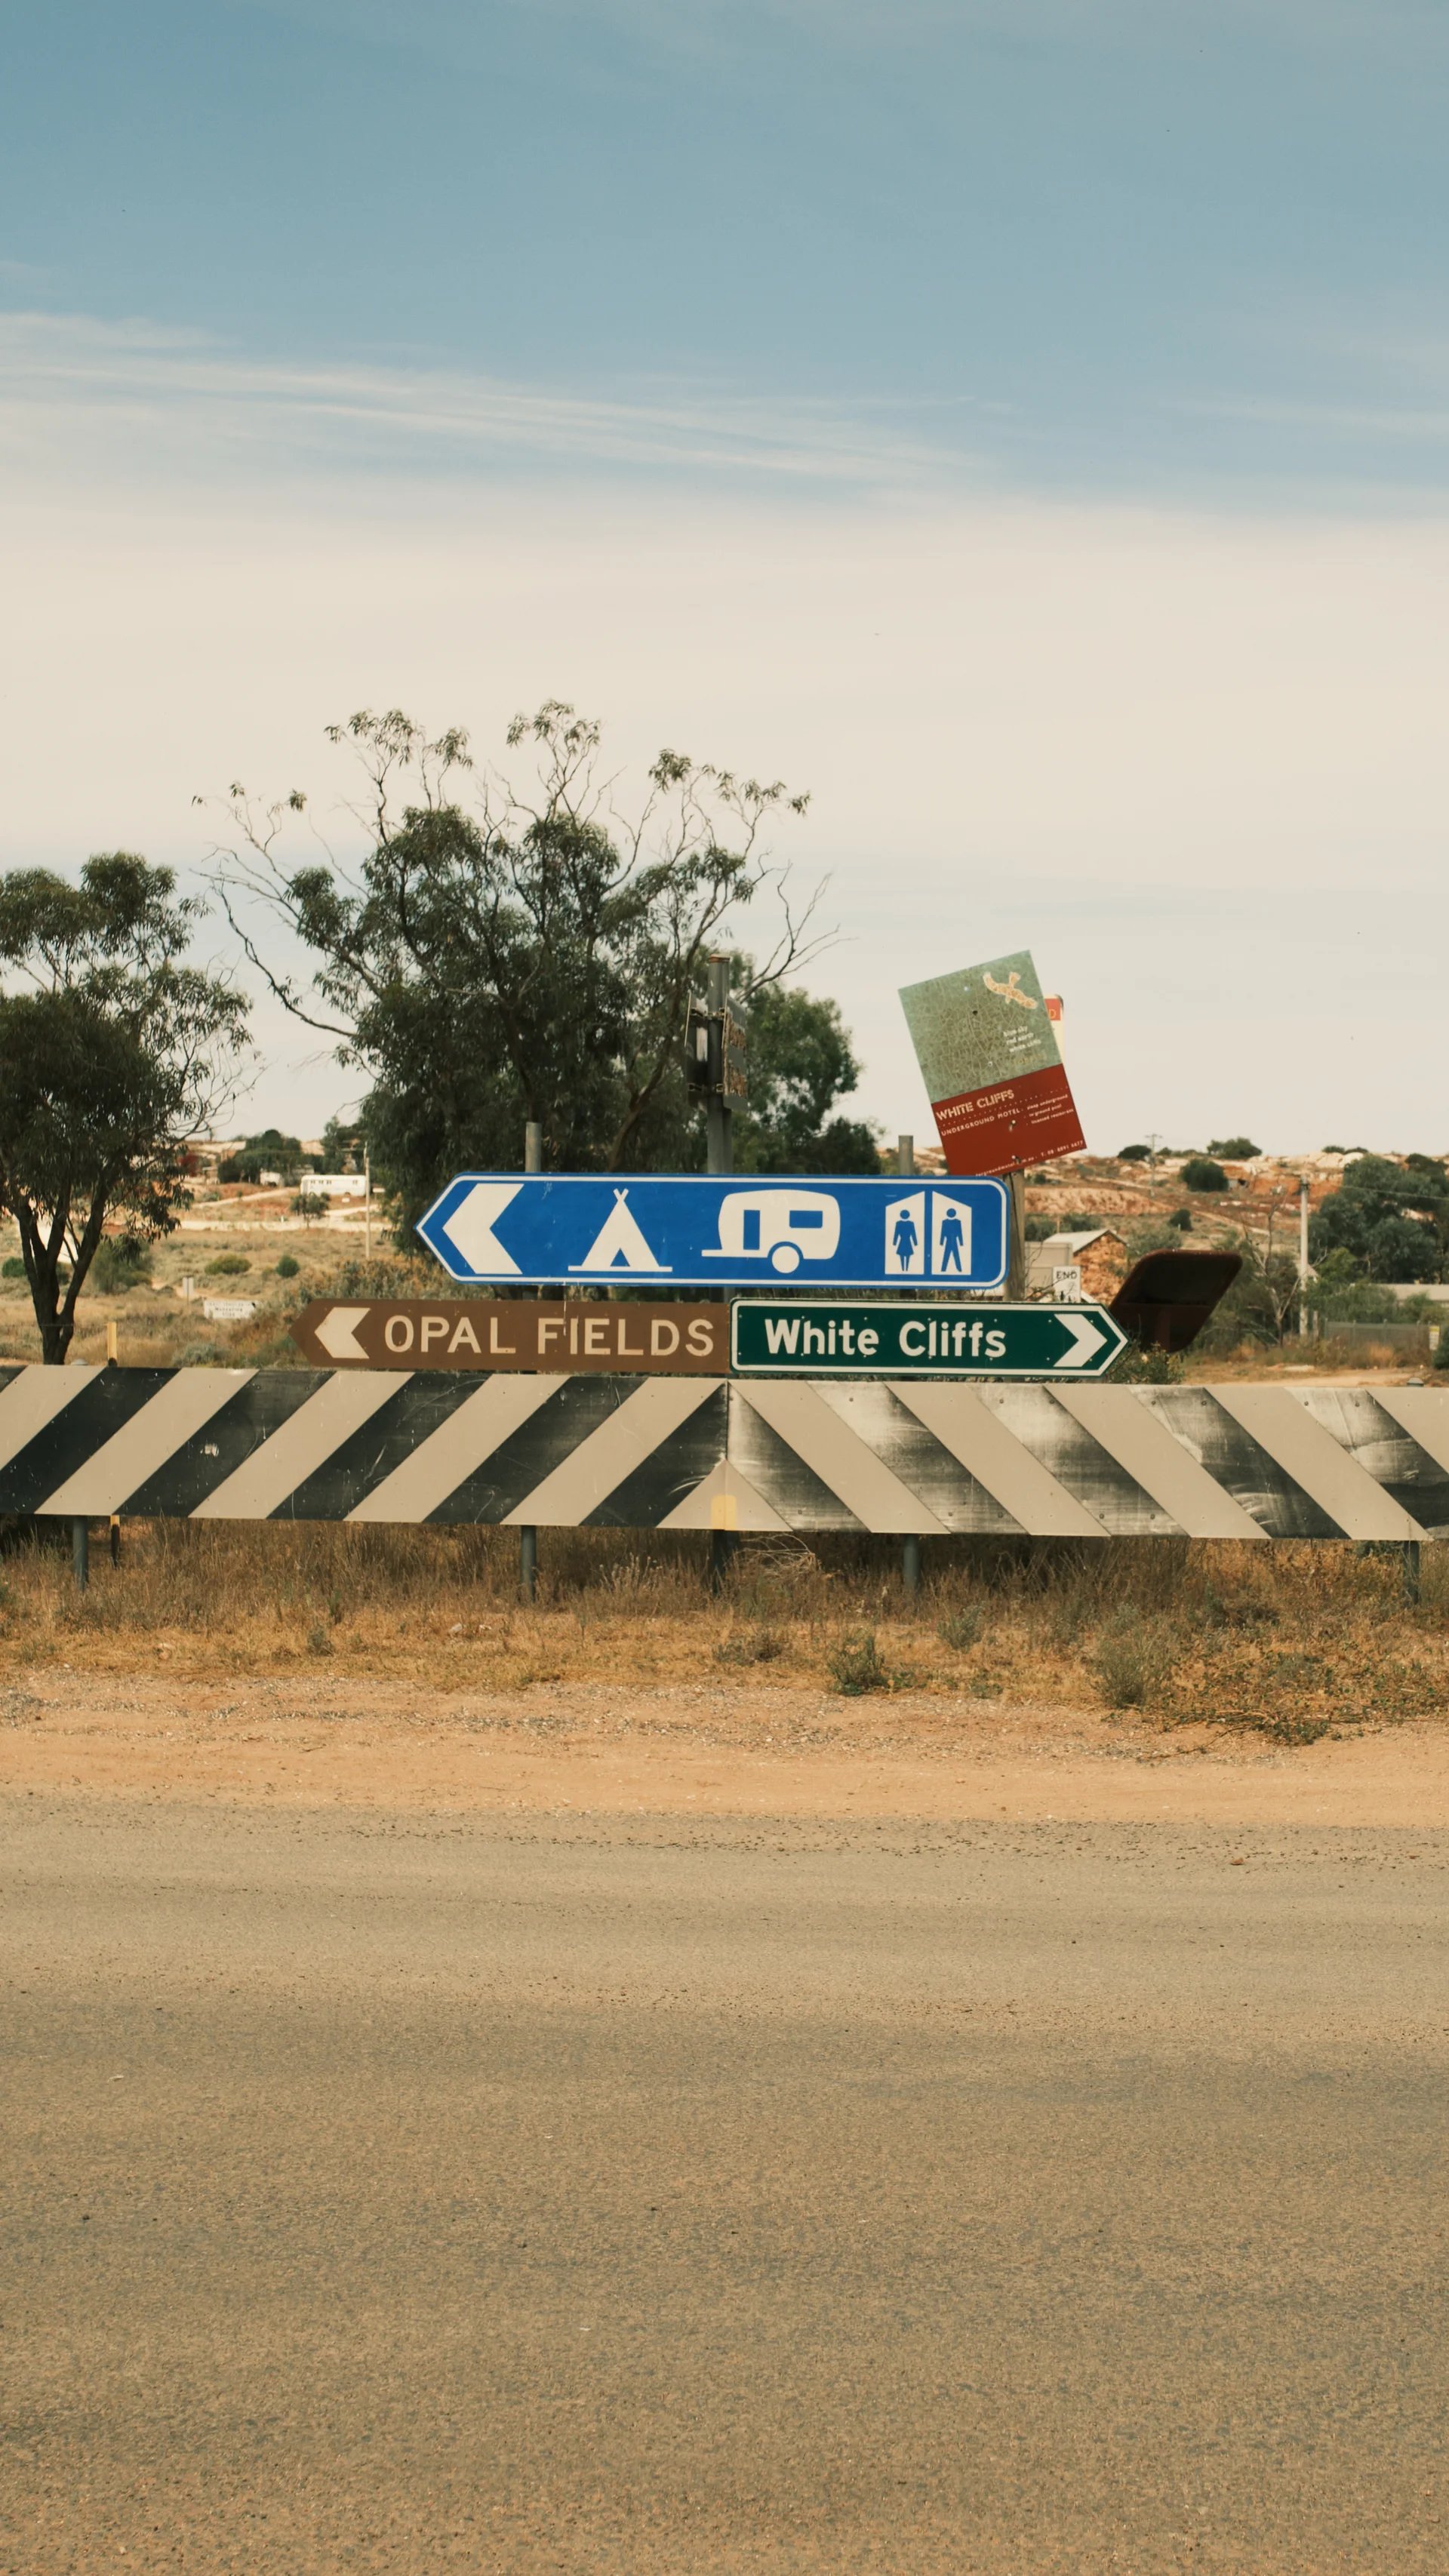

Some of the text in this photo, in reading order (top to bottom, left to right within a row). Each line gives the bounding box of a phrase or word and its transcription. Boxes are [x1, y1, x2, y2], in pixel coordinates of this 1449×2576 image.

[936, 1089, 1015, 1121] WHITE CLIFFS
[941, 1108, 1020, 1136] UNDERGROUND MOTEL
[384, 1315, 714, 1357] OPAL FIELDS
[764, 1319, 1007, 1358] White Cliffs
